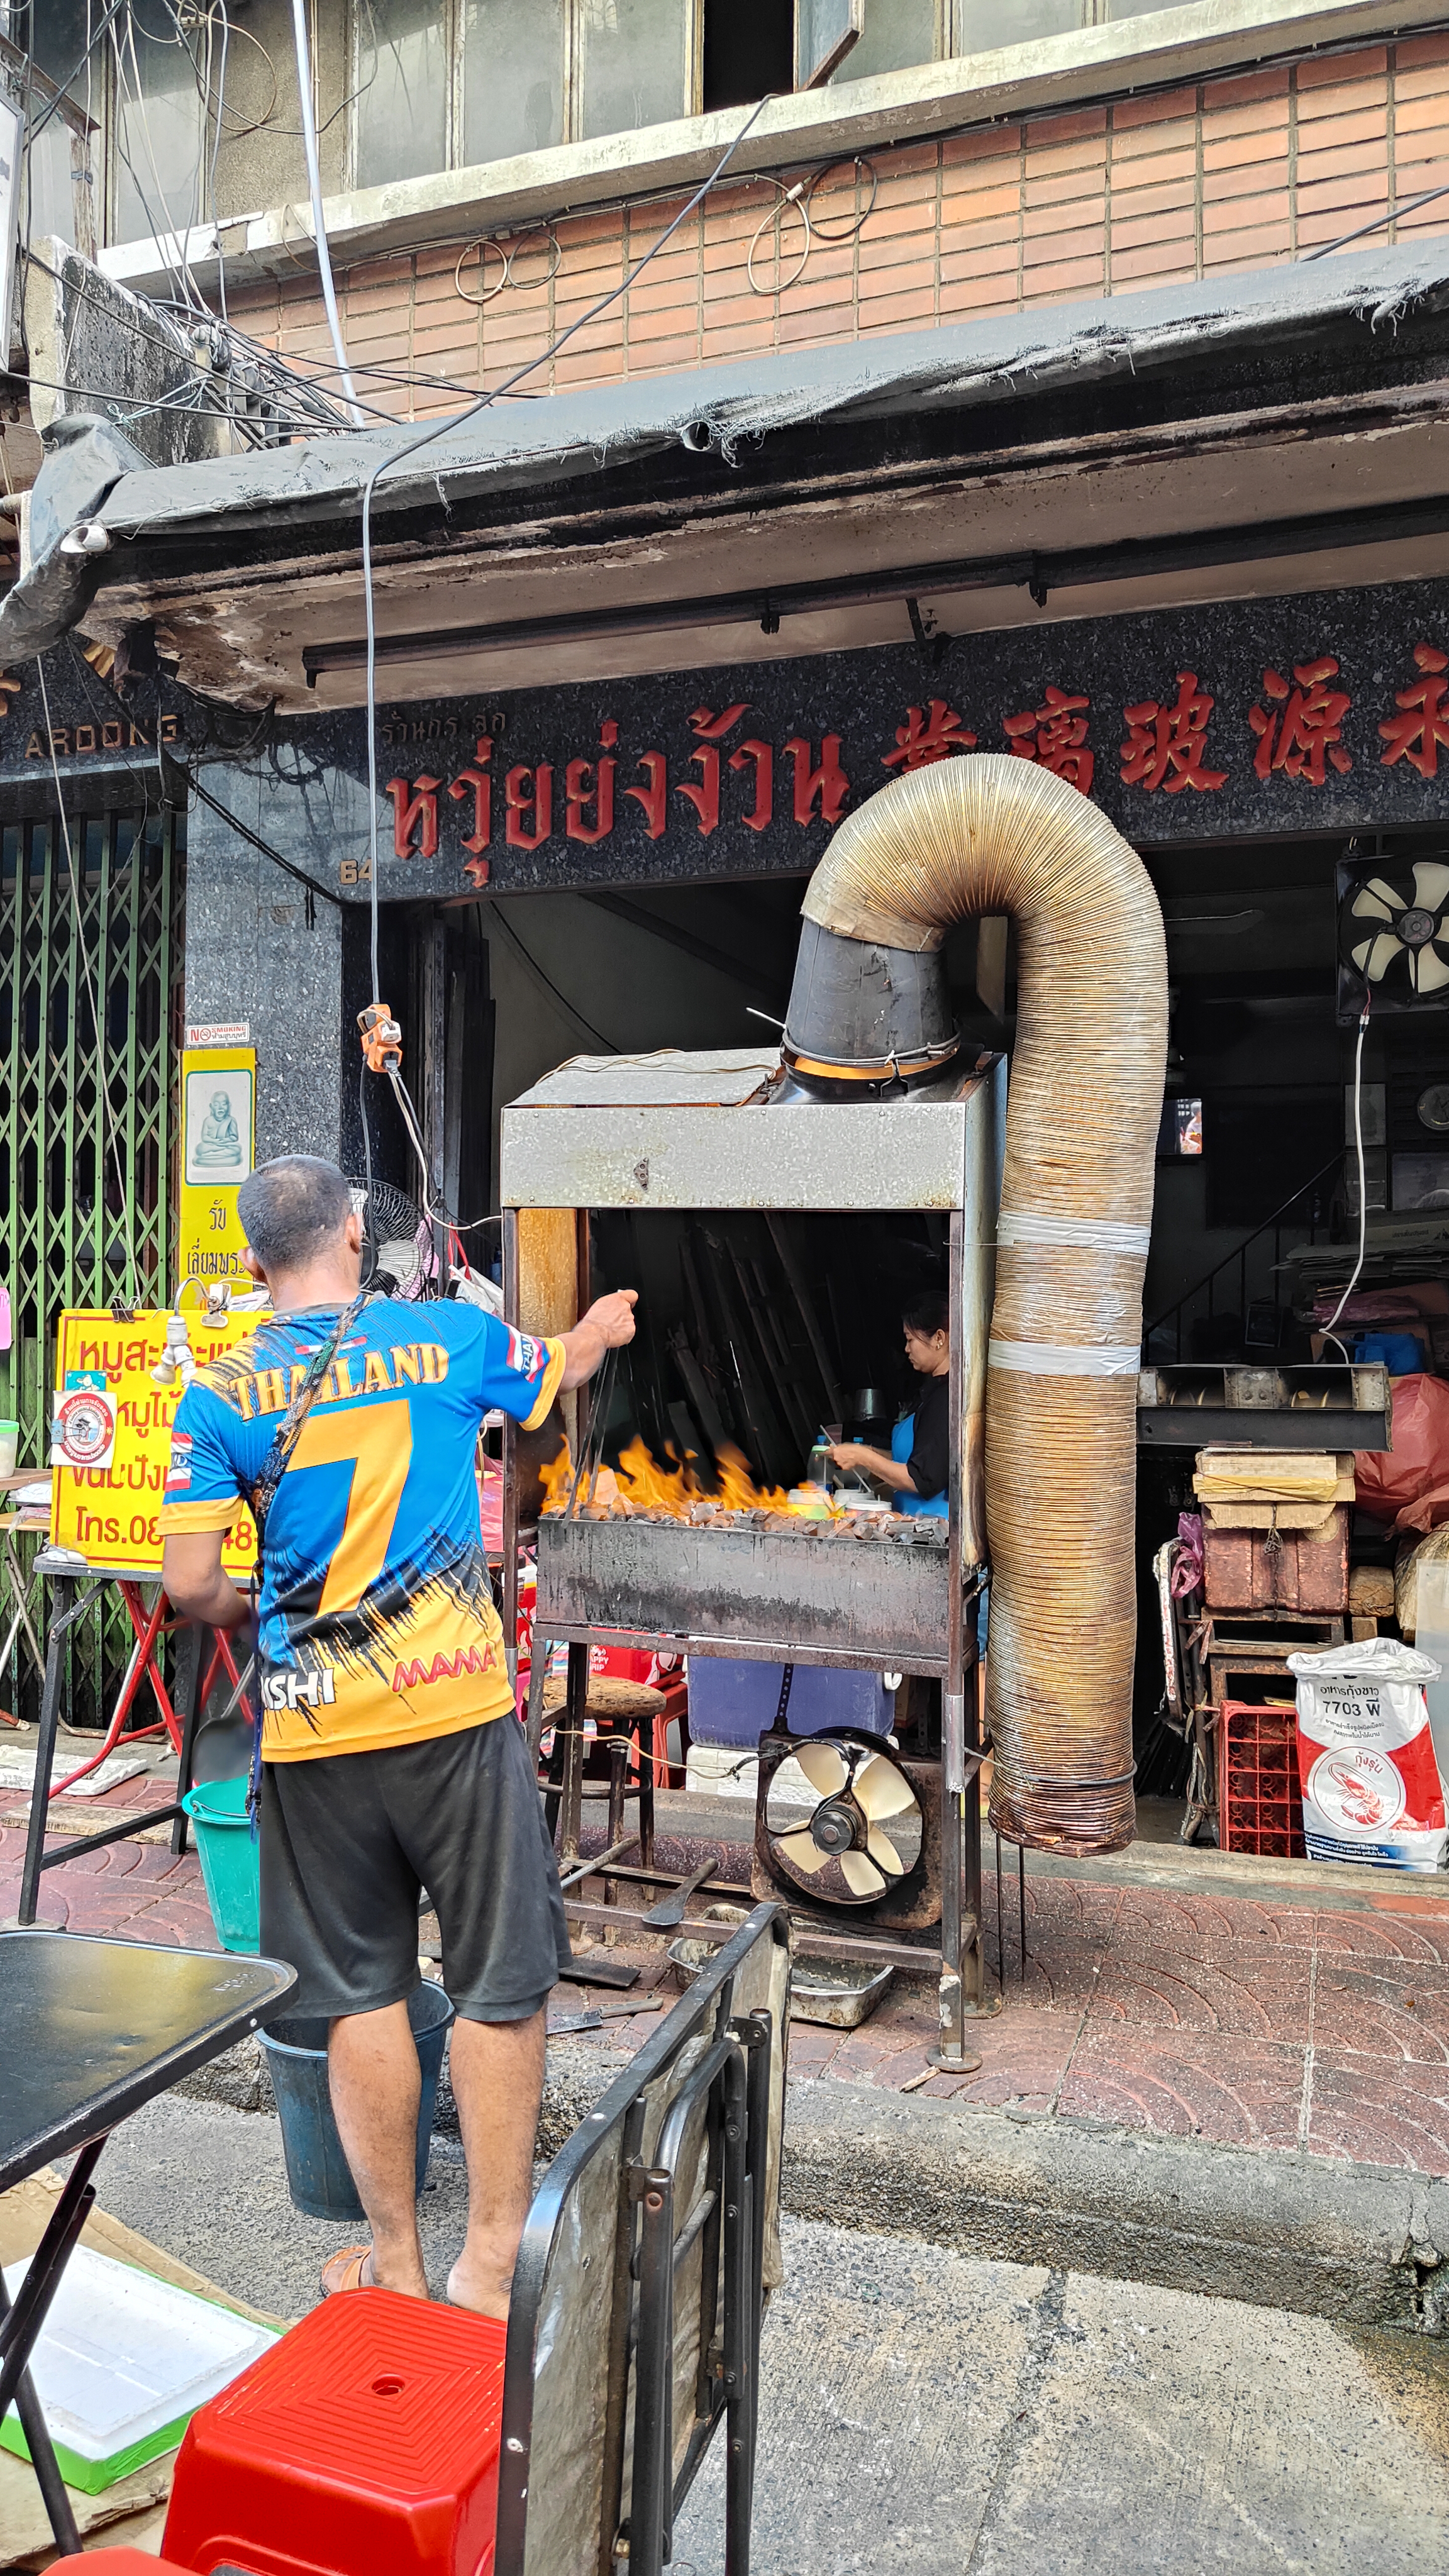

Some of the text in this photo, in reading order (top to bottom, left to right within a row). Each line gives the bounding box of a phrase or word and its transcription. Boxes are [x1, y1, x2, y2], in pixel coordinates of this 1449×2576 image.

[209, 1199, 226, 1230] รับ
[275, 1399, 413, 1620] 7
[392, 1641, 497, 1693] MAMA
[590, 1656, 609, 1665] APPY
[260, 1667, 335, 1710] ISHI
[1323, 1698, 1380, 1717] 7703 พี
